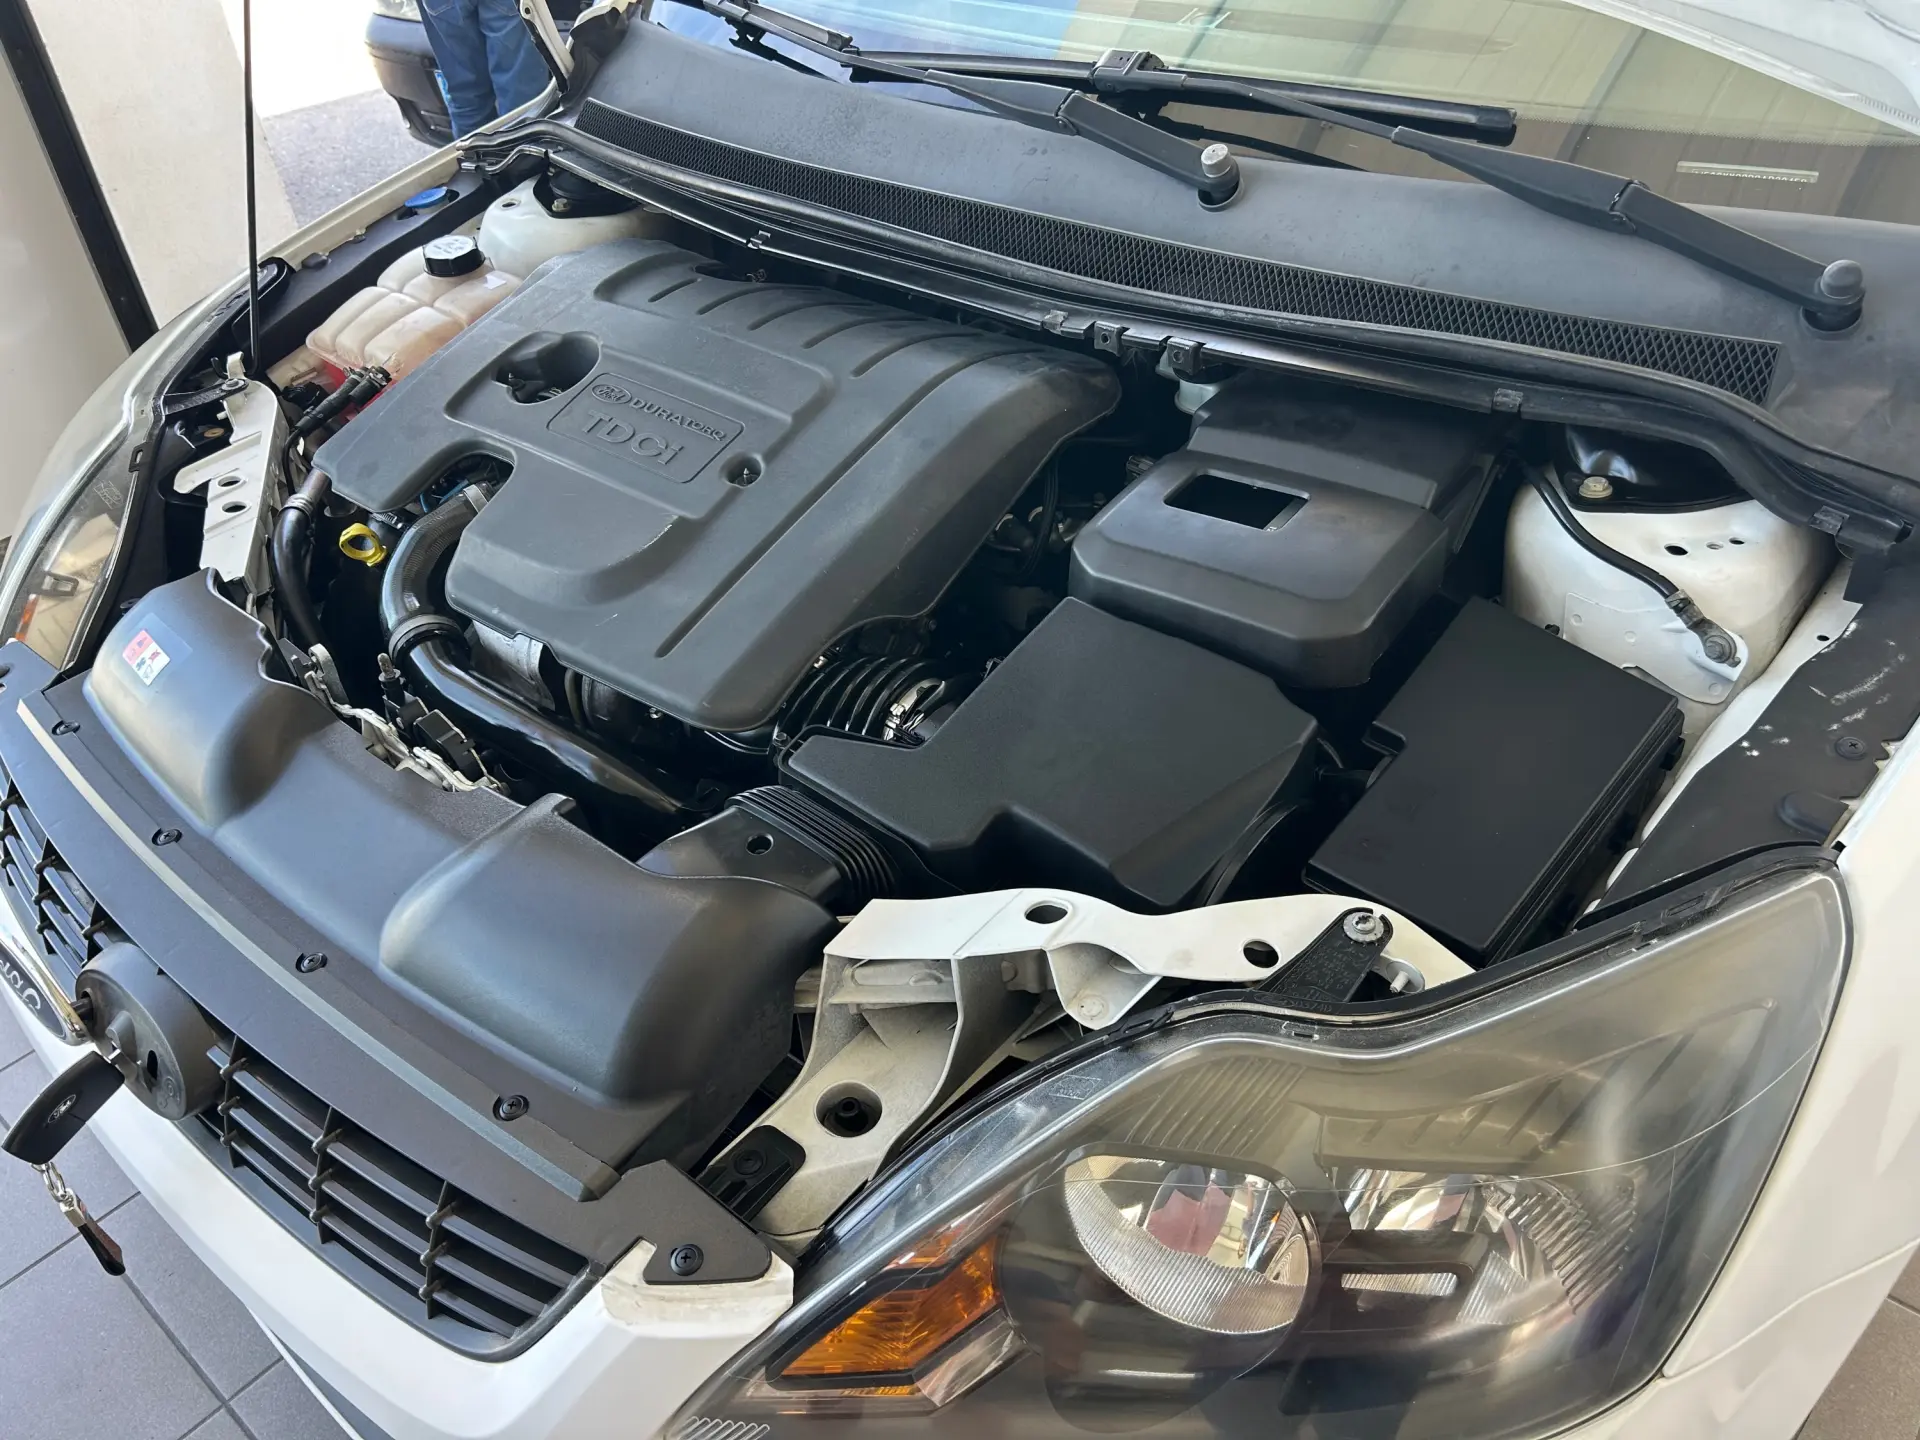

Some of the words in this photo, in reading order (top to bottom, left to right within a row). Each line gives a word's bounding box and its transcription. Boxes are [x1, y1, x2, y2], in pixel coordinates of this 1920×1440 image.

[582, 408, 685, 466] TDCi
[597, 385, 628, 403] Ford
[629, 397, 727, 442] DURATORQ
